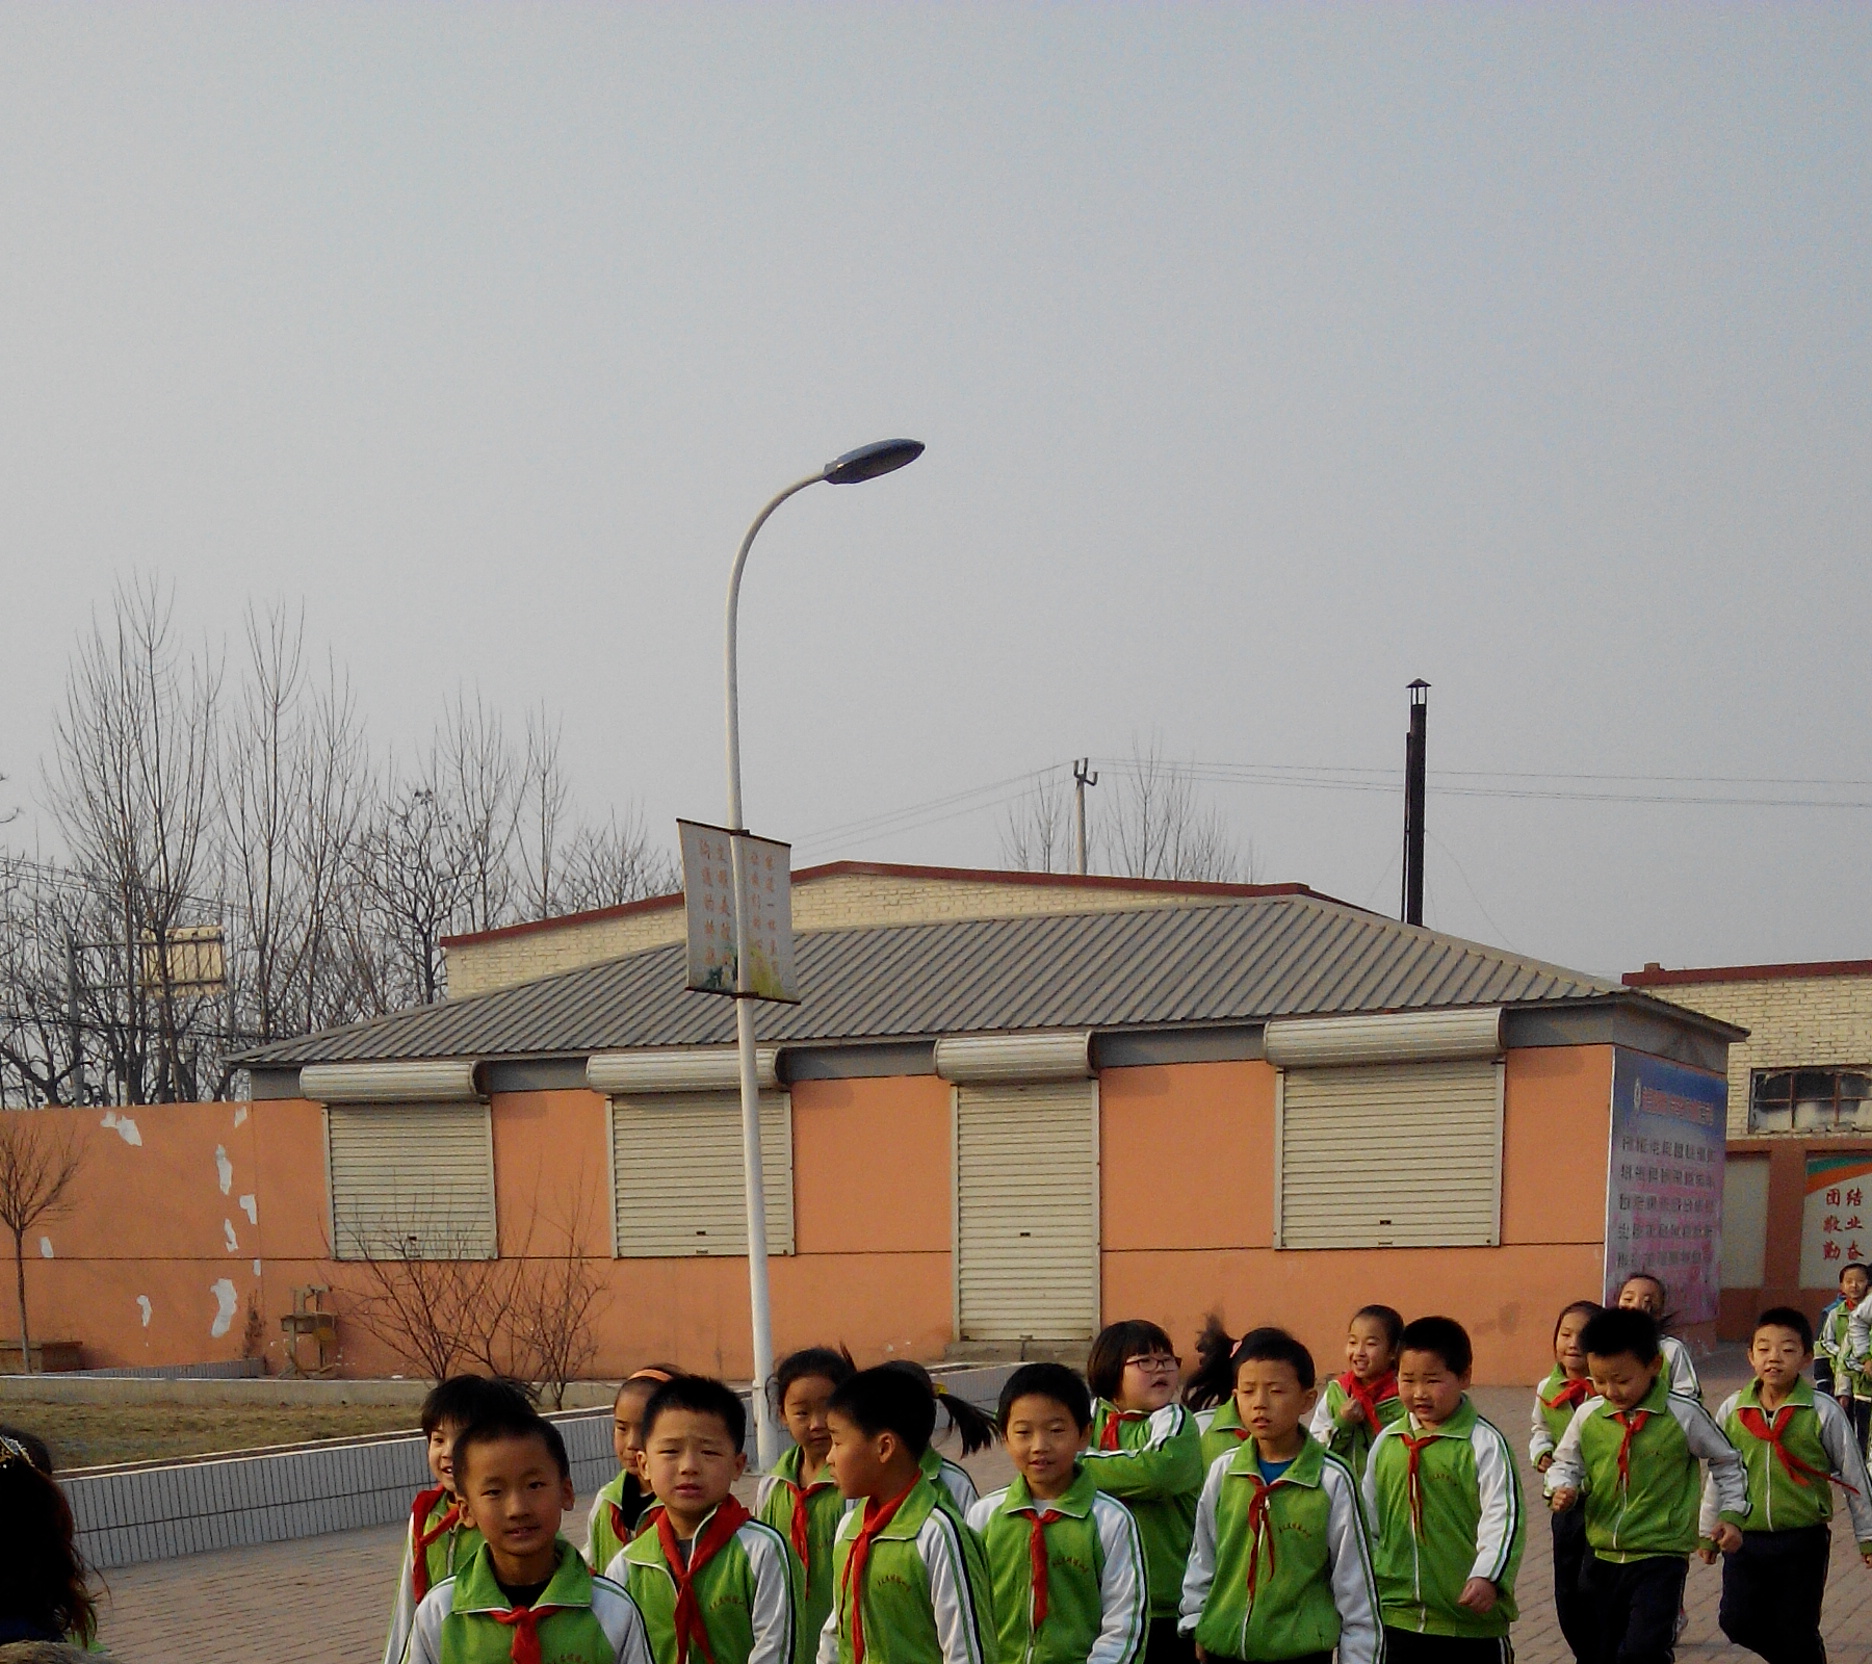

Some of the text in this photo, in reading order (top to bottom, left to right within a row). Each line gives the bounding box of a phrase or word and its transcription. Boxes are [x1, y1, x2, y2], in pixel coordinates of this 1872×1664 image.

[1826, 1186, 1863, 1207] 团结
[1823, 1215, 1863, 1233] 敬业
[1823, 1240, 1864, 1260] 勤奋
